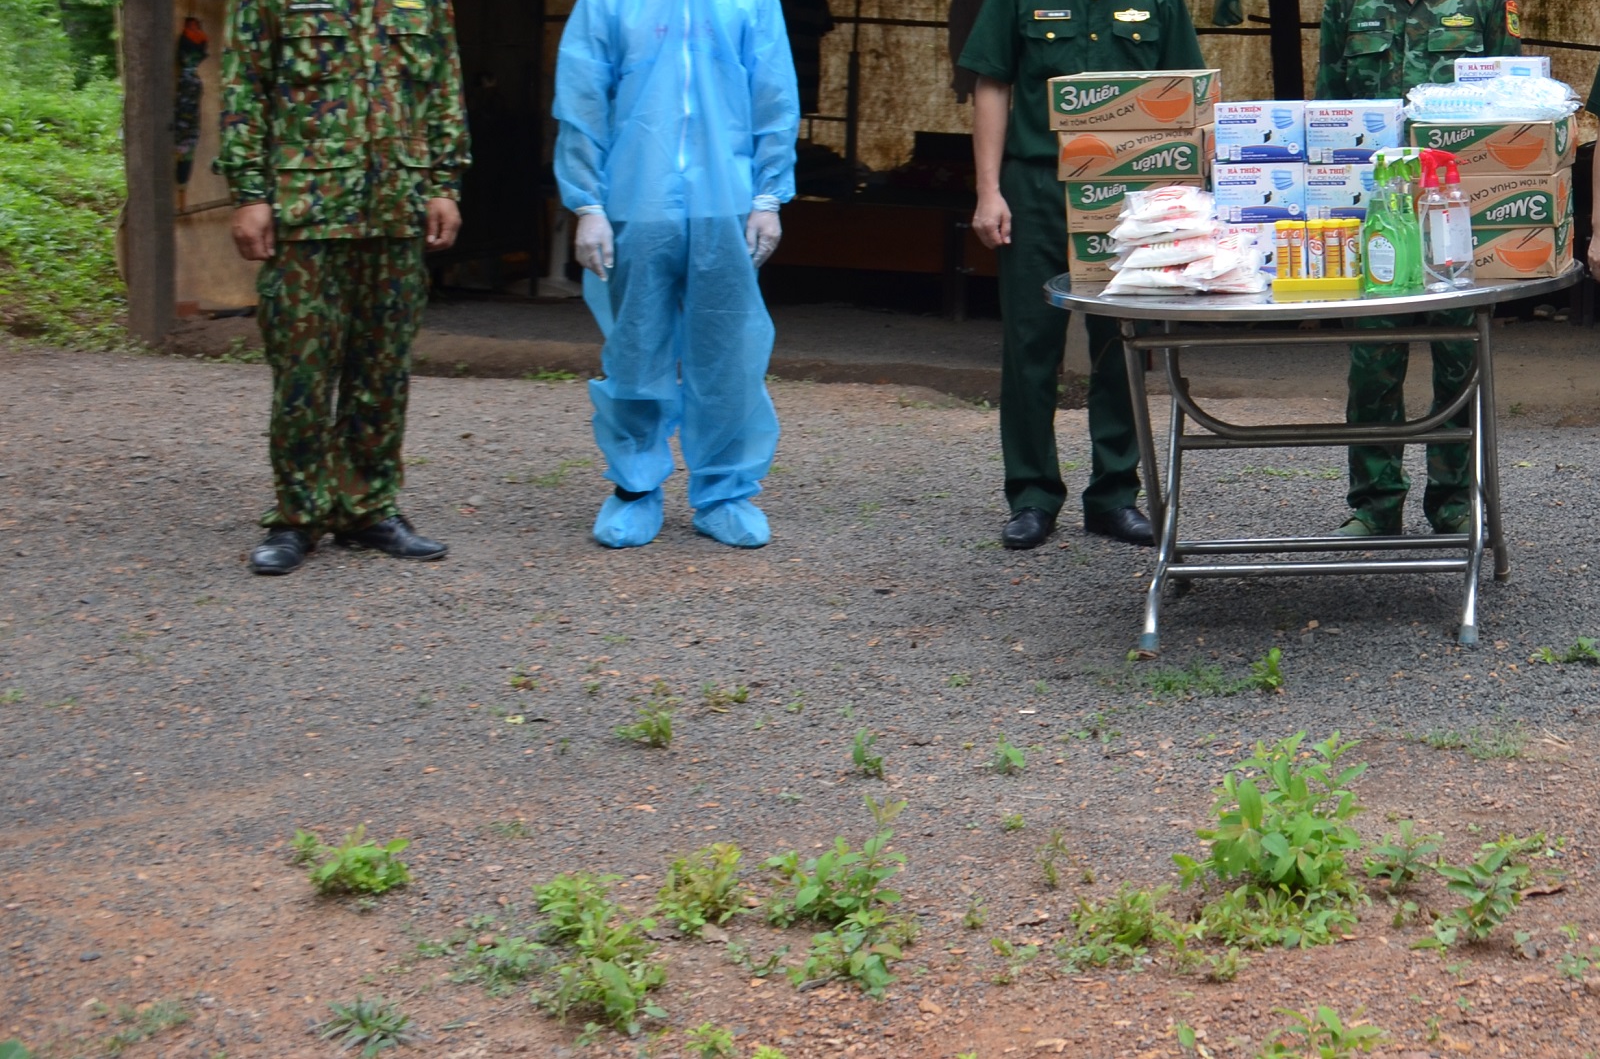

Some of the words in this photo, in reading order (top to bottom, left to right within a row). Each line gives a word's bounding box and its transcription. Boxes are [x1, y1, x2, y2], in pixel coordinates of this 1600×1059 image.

[1088, 111, 1115, 124] CHUA
[1116, 103, 1136, 117] CAY
[1136, 133, 1164, 145] CHUA
[1115, 140, 1135, 154] CAY
[1472, 153, 1488, 164] CAY
[1490, 181, 1518, 194] CHUA
[1469, 189, 1489, 203] CAY
[1475, 253, 1494, 268] CAY
